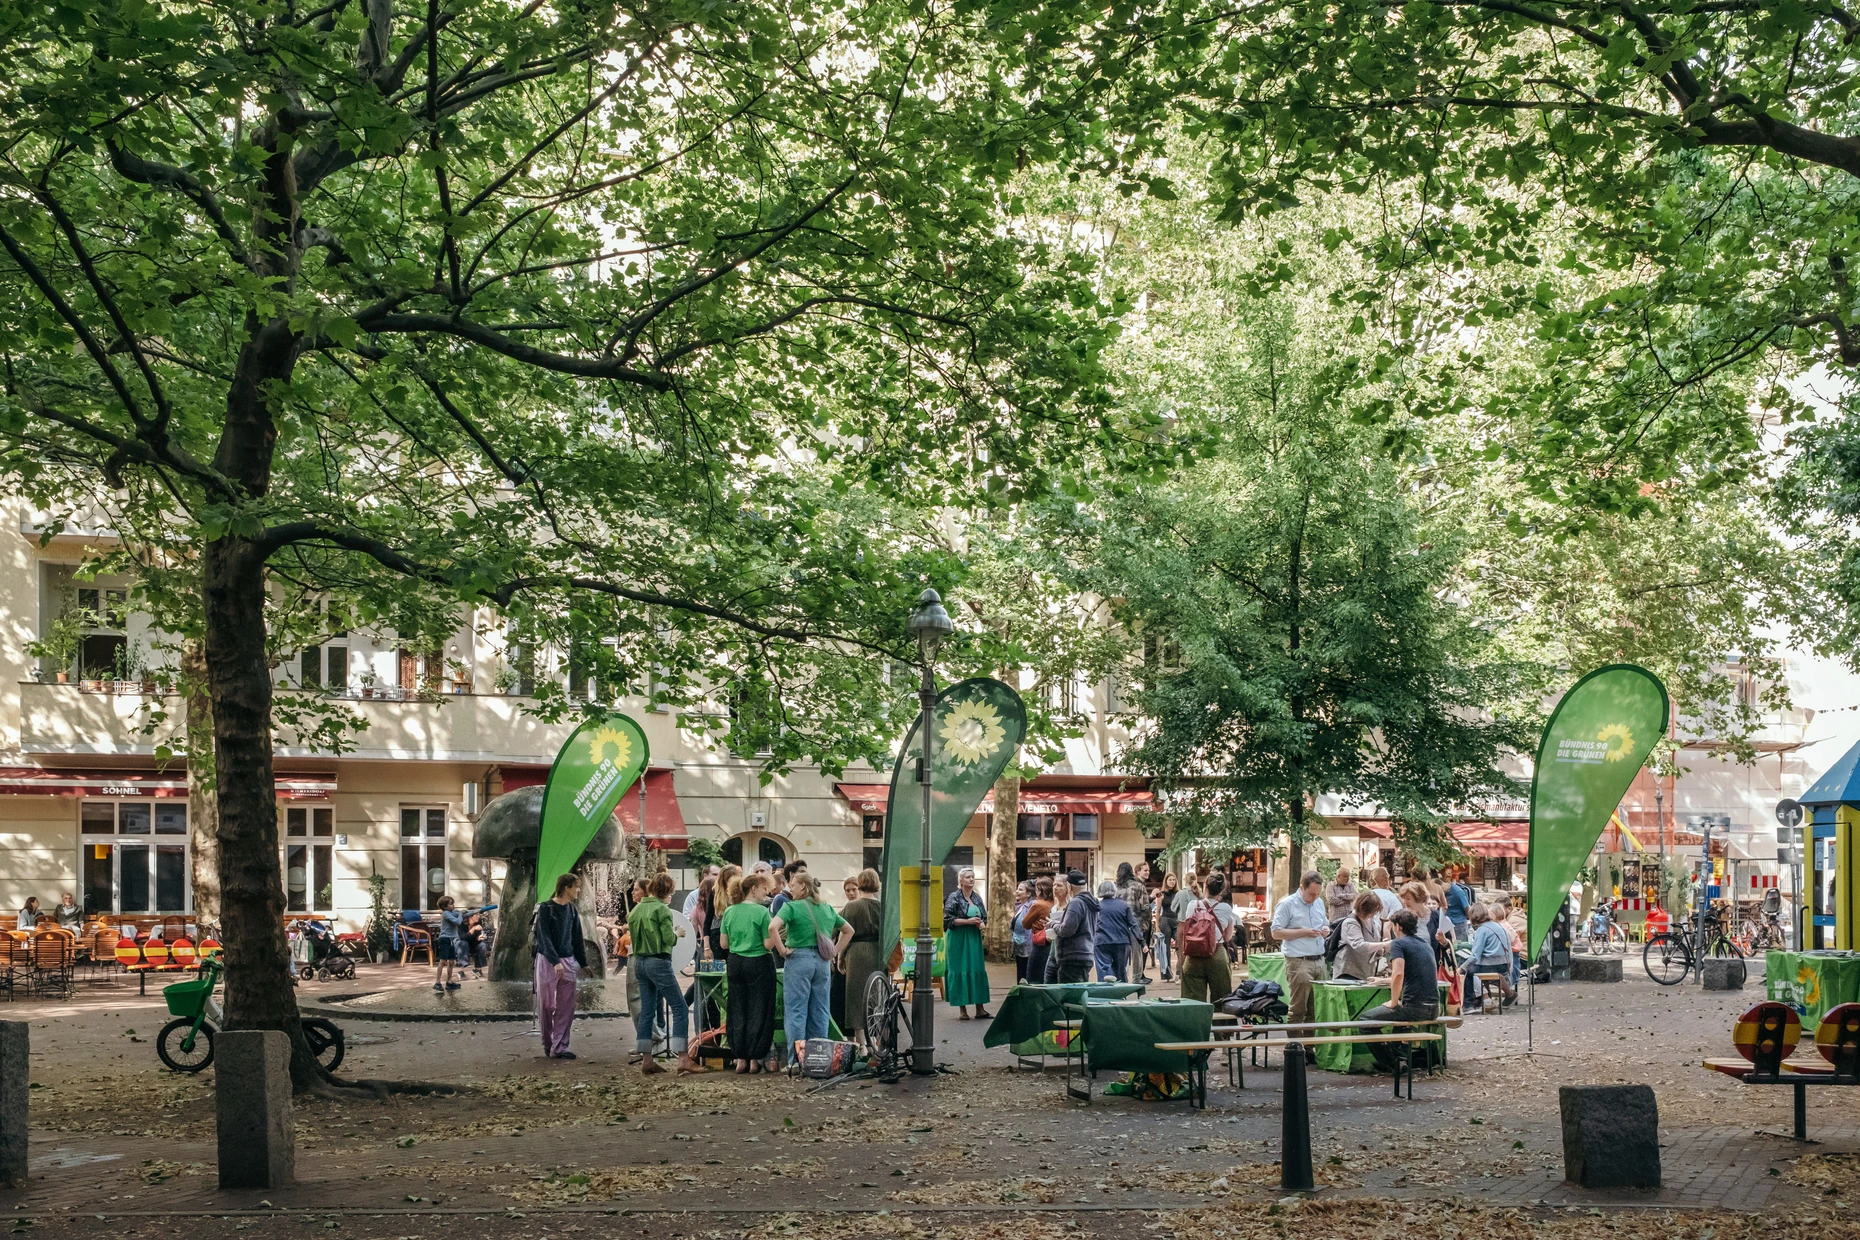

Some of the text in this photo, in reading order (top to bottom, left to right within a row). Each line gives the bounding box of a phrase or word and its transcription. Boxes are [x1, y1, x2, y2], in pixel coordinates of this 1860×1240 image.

[1559, 738, 1608, 750] BÜNDNIS 90
[1556, 748, 1606, 759] DIE GRÜNEN
[573, 758, 611, 809] BÜNDNIS 90
[579, 766, 619, 817] DIE GRÜNEN
[1021, 804, 1058, 813] VENETO
